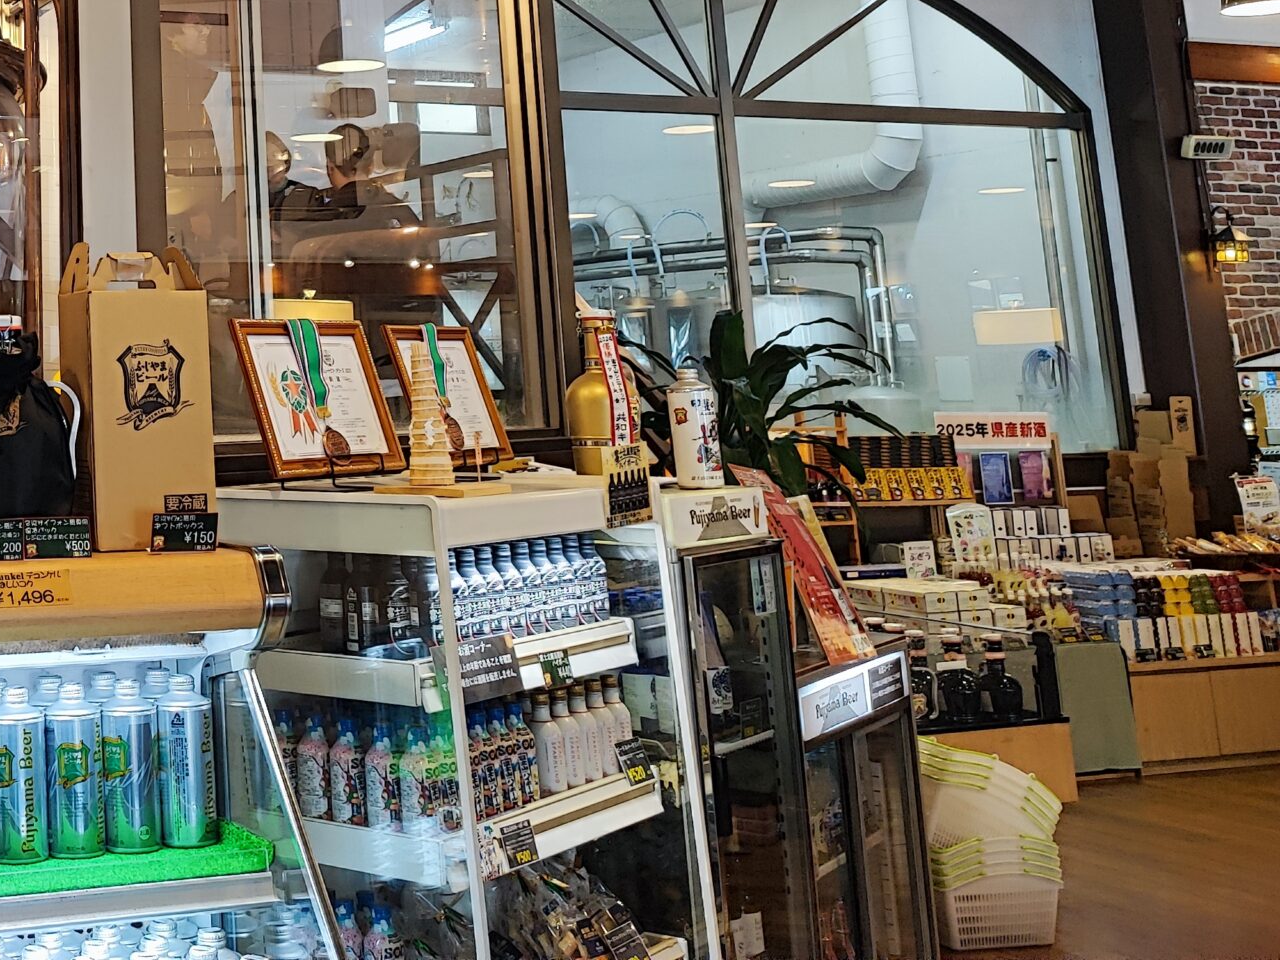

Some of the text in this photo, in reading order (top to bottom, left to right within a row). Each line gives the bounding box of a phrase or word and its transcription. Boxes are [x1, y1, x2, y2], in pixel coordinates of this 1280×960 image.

[135, 360, 168, 372] ふじやま
[136, 371, 168, 382] ビール
[936, 422, 1048, 438] 2025年 県産新酒
[165, 495, 207, 511] 要冷蔵
[689, 504, 751, 528] Fujiyama Beer
[184, 530, 215, 543] ¥150
[65, 540, 91, 551] ¥500
[628, 765, 646, 782] ¥520
[18, 728, 39, 854] Fujiyama Beer
[515, 849, 532, 865] ¥500
